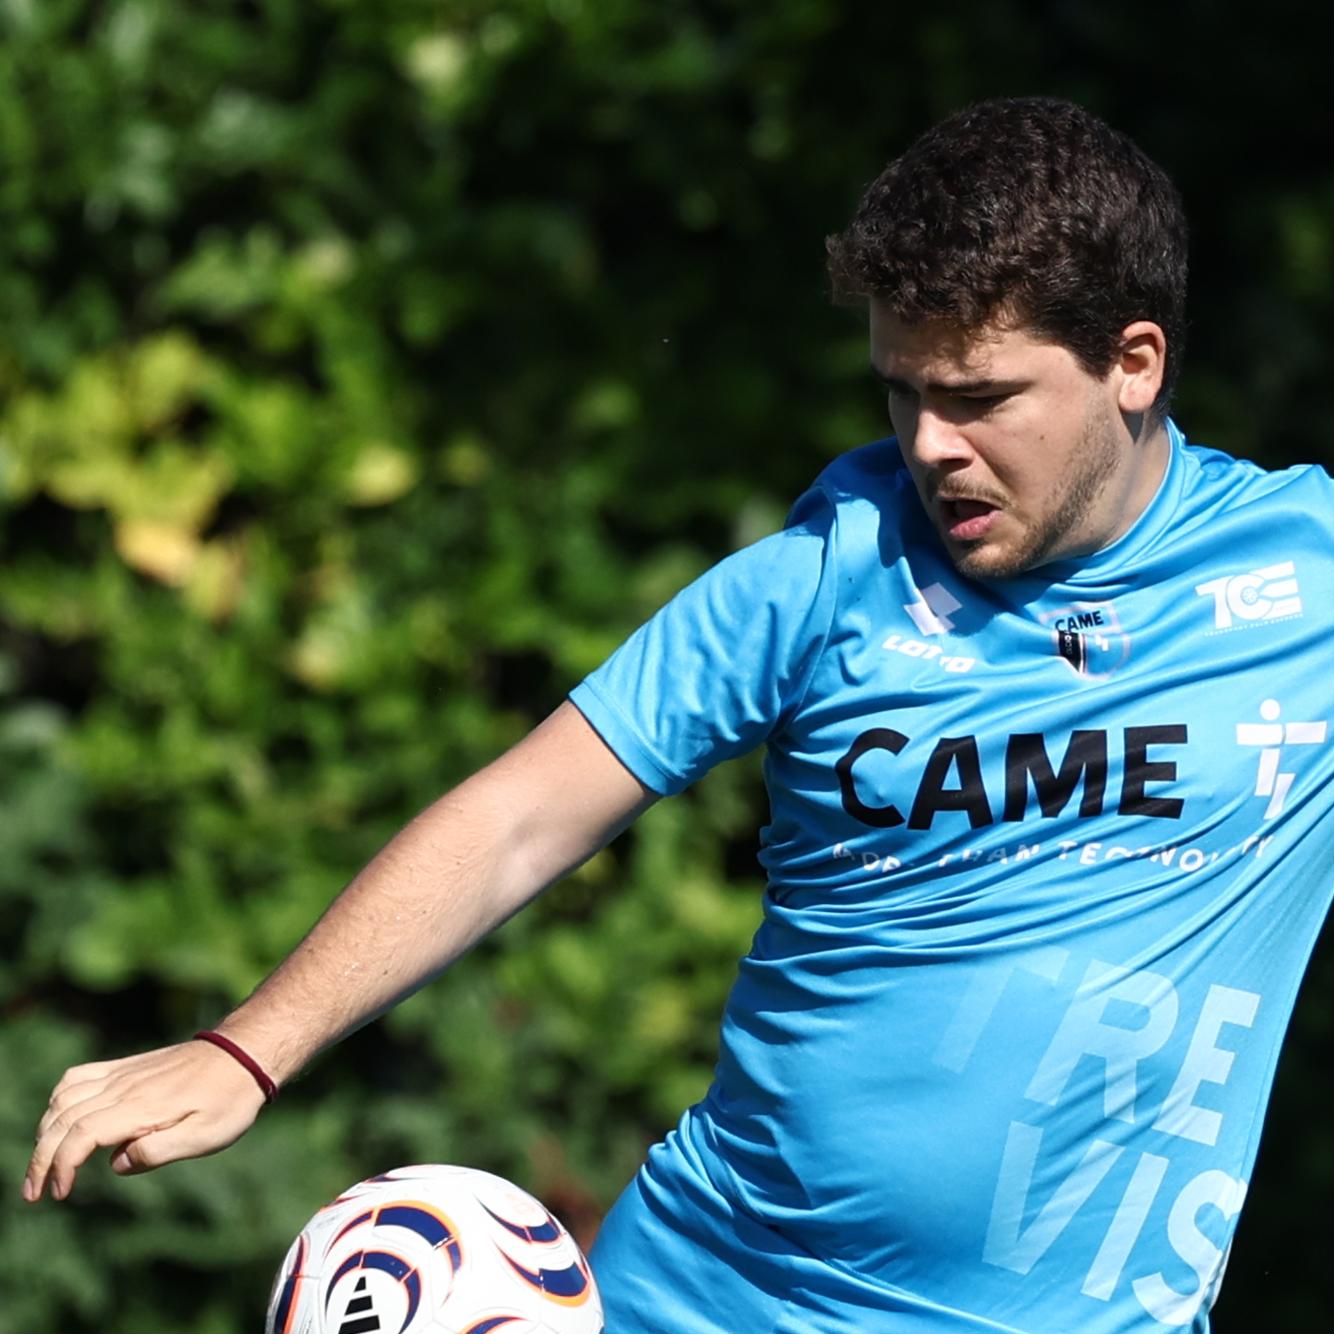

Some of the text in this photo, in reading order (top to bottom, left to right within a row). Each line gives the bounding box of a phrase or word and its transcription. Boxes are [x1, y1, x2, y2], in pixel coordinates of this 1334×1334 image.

[1055, 610, 1104, 633] CAME
[834, 723, 1189, 831] CAME
[931, 940, 1262, 1147] TRE
